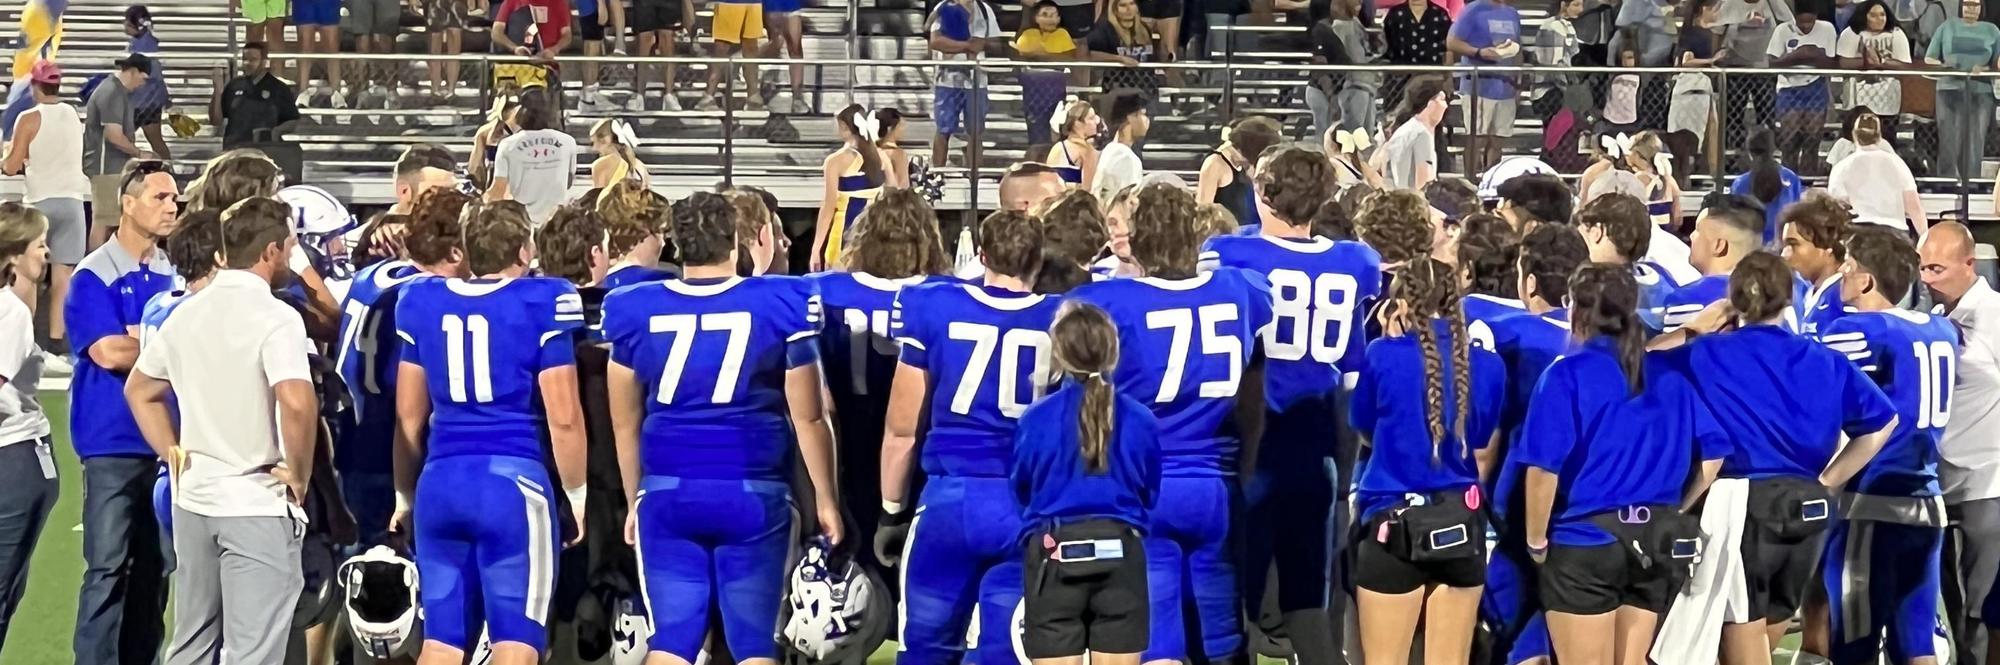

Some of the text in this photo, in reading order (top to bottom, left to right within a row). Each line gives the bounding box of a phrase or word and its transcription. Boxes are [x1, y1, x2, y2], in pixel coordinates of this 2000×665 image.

[335, 298, 381, 394] 74
[441, 314, 494, 403] 11
[649, 312, 751, 405] 77
[1146, 303, 1242, 403] 75
[1263, 268, 1358, 364] 88
[948, 322, 1052, 418] 70
[1912, 341, 1956, 429] 10
